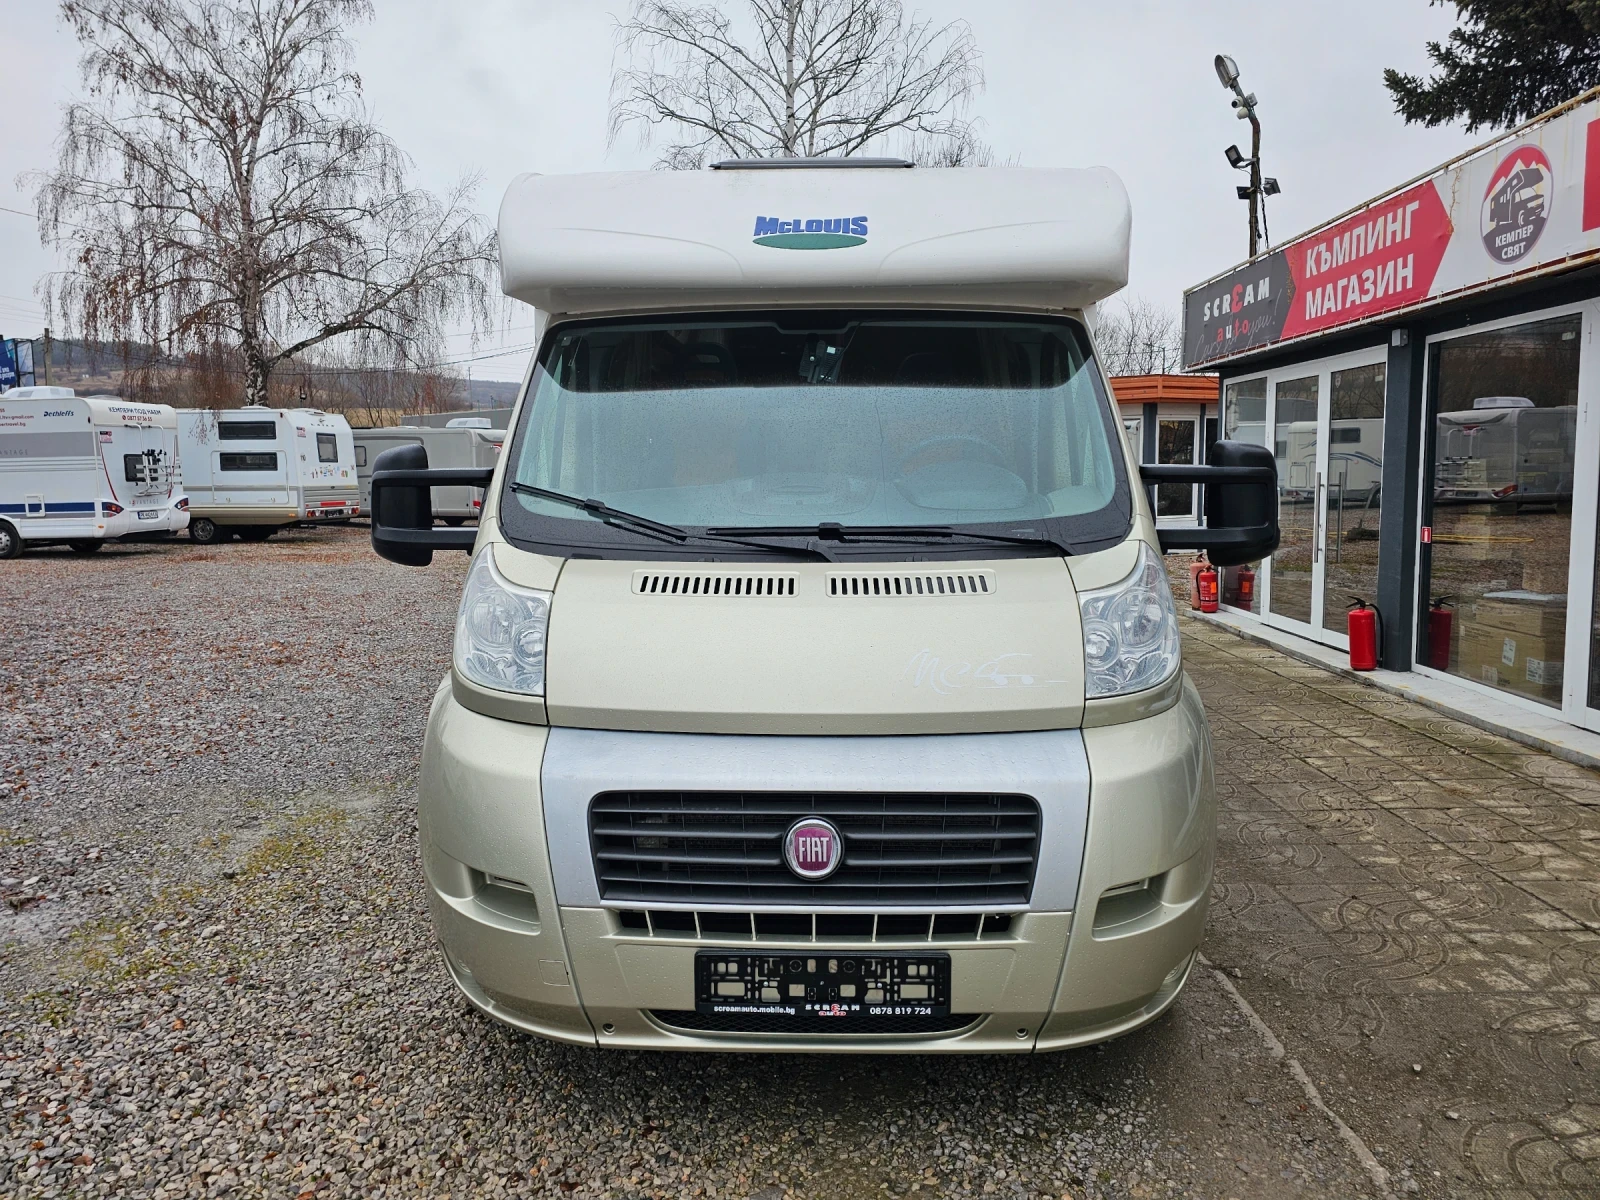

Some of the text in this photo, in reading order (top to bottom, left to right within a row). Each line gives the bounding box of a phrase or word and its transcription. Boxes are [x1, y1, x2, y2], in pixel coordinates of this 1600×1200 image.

[1305, 200, 1420, 279] КЪМПИНГ
[1495, 224, 1534, 248] КЕМПЕР
[1501, 242, 1526, 259] СВЯТ
[1203, 276, 1270, 322] SCREAM
[1305, 253, 1414, 321] МАГАЗИН
[1216, 318, 1249, 343] auto
[798, 836, 830, 863] FIAT
[714, 1006, 796, 1015] screamauto.mobile.bg
[805, 1003, 860, 1013] SCREAM
[869, 1007, 932, 1015] 0878 819 724
